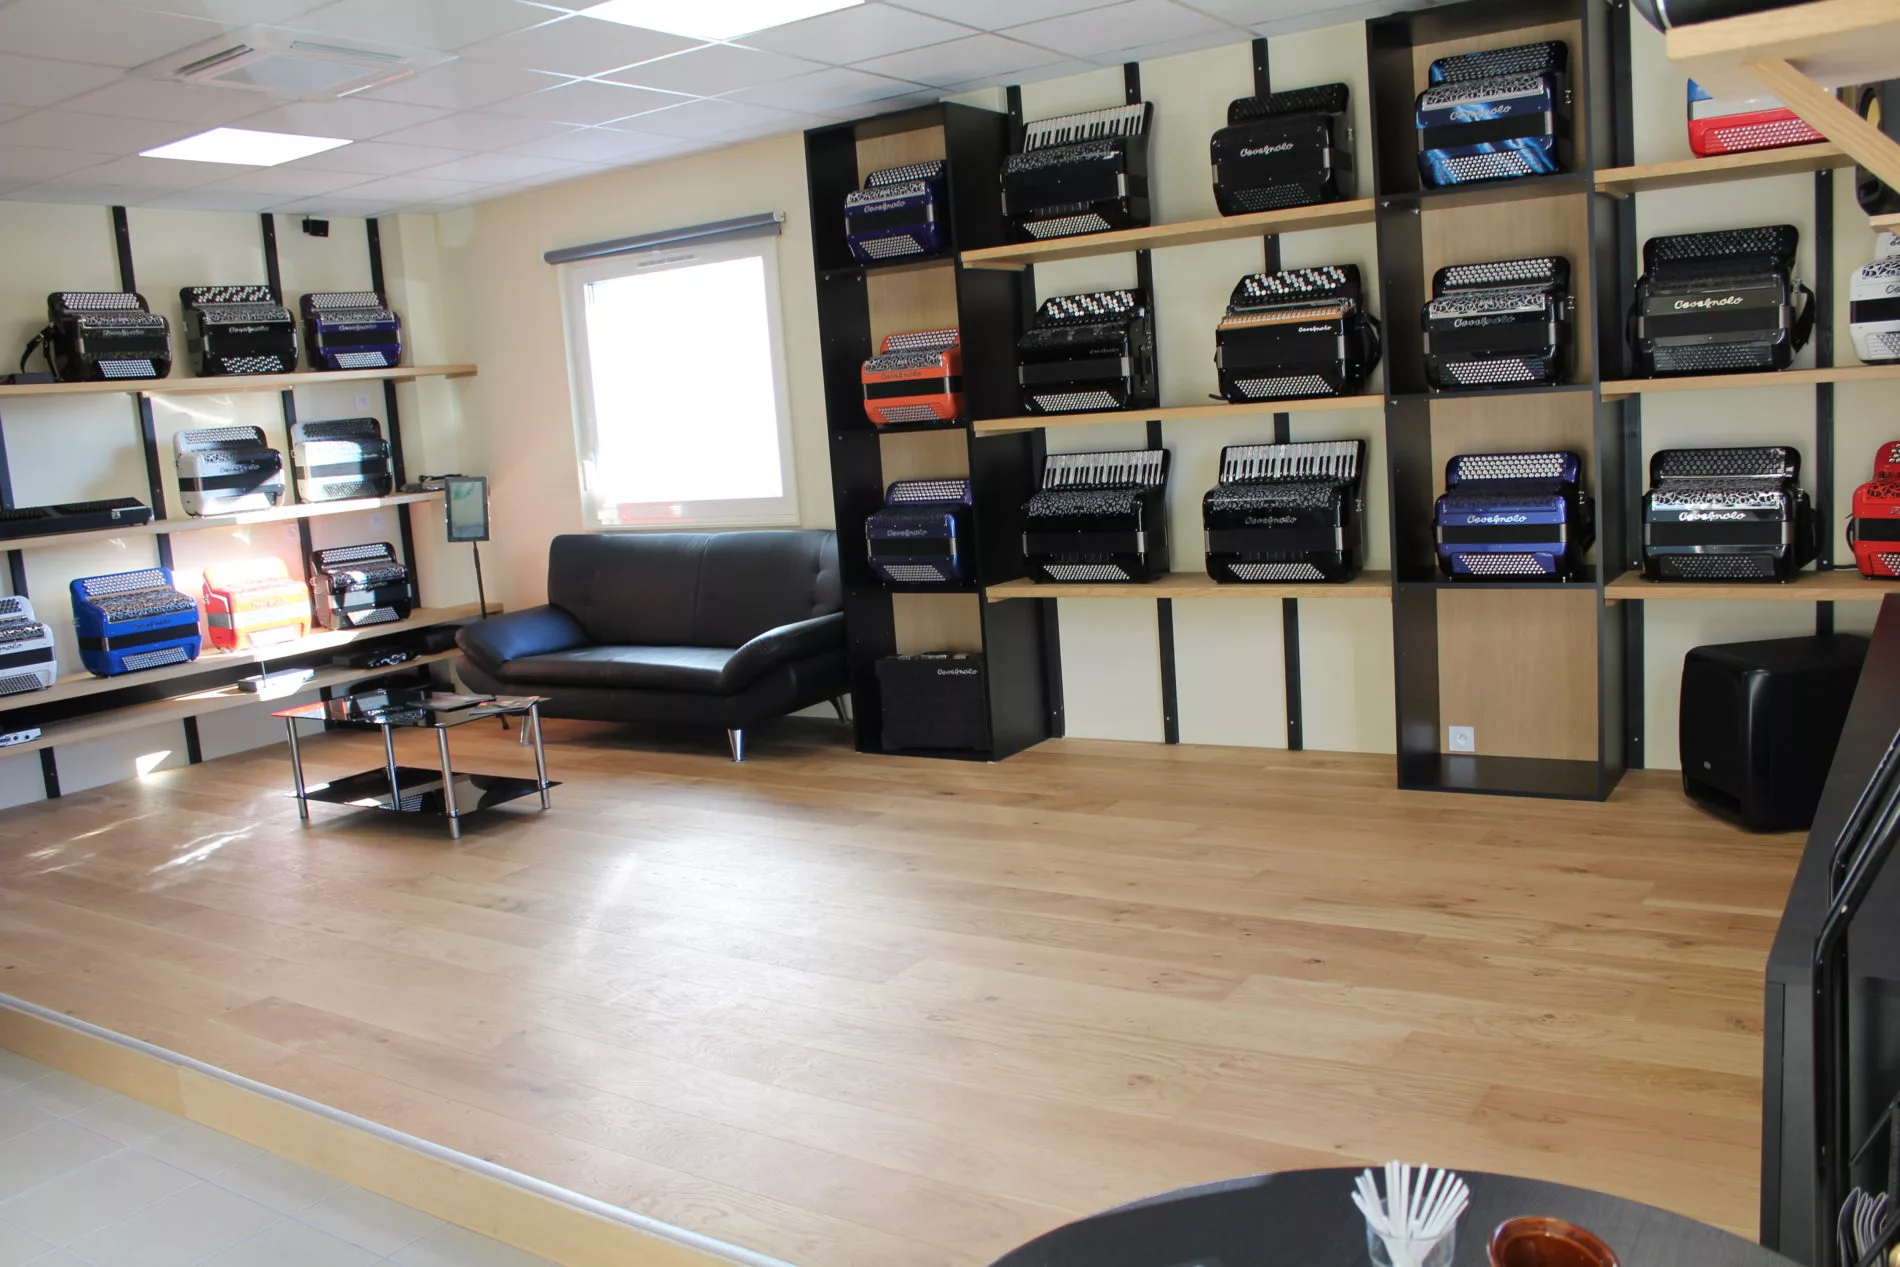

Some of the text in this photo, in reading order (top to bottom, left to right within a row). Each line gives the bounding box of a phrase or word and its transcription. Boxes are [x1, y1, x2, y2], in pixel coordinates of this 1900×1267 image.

[1240, 142, 1294, 157] Cavagnolo
[1674, 296, 1743, 309] Cavagnolo
[1467, 514, 1527, 525] Cavagnolo
[1678, 511, 1746, 521] Cavagnolo
